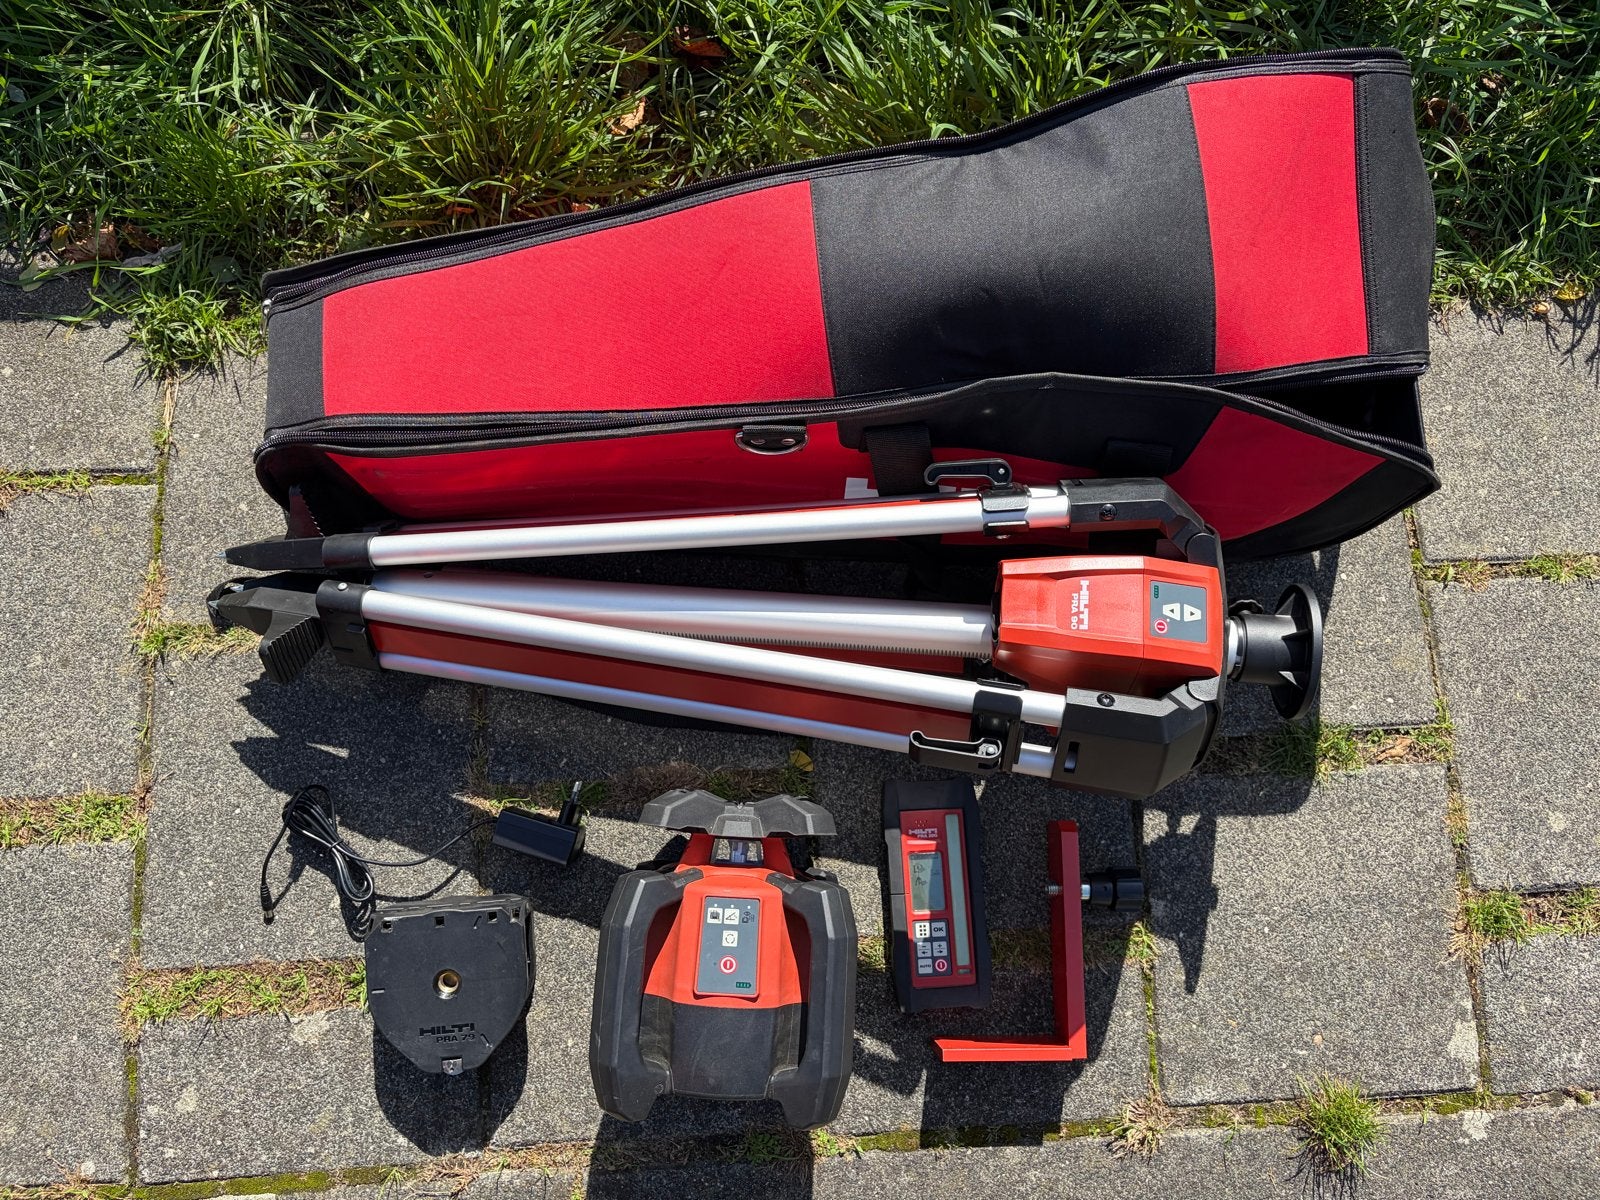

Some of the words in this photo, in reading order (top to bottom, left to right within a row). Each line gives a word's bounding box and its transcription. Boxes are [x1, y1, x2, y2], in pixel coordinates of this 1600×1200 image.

[1071, 593, 1079, 614] PRA
[1079, 580, 1089, 630] HILTI
[1070, 615, 1079, 630] 90
[419, 1023, 475, 1037] HILTI
[436, 1034, 458, 1043] PRA
